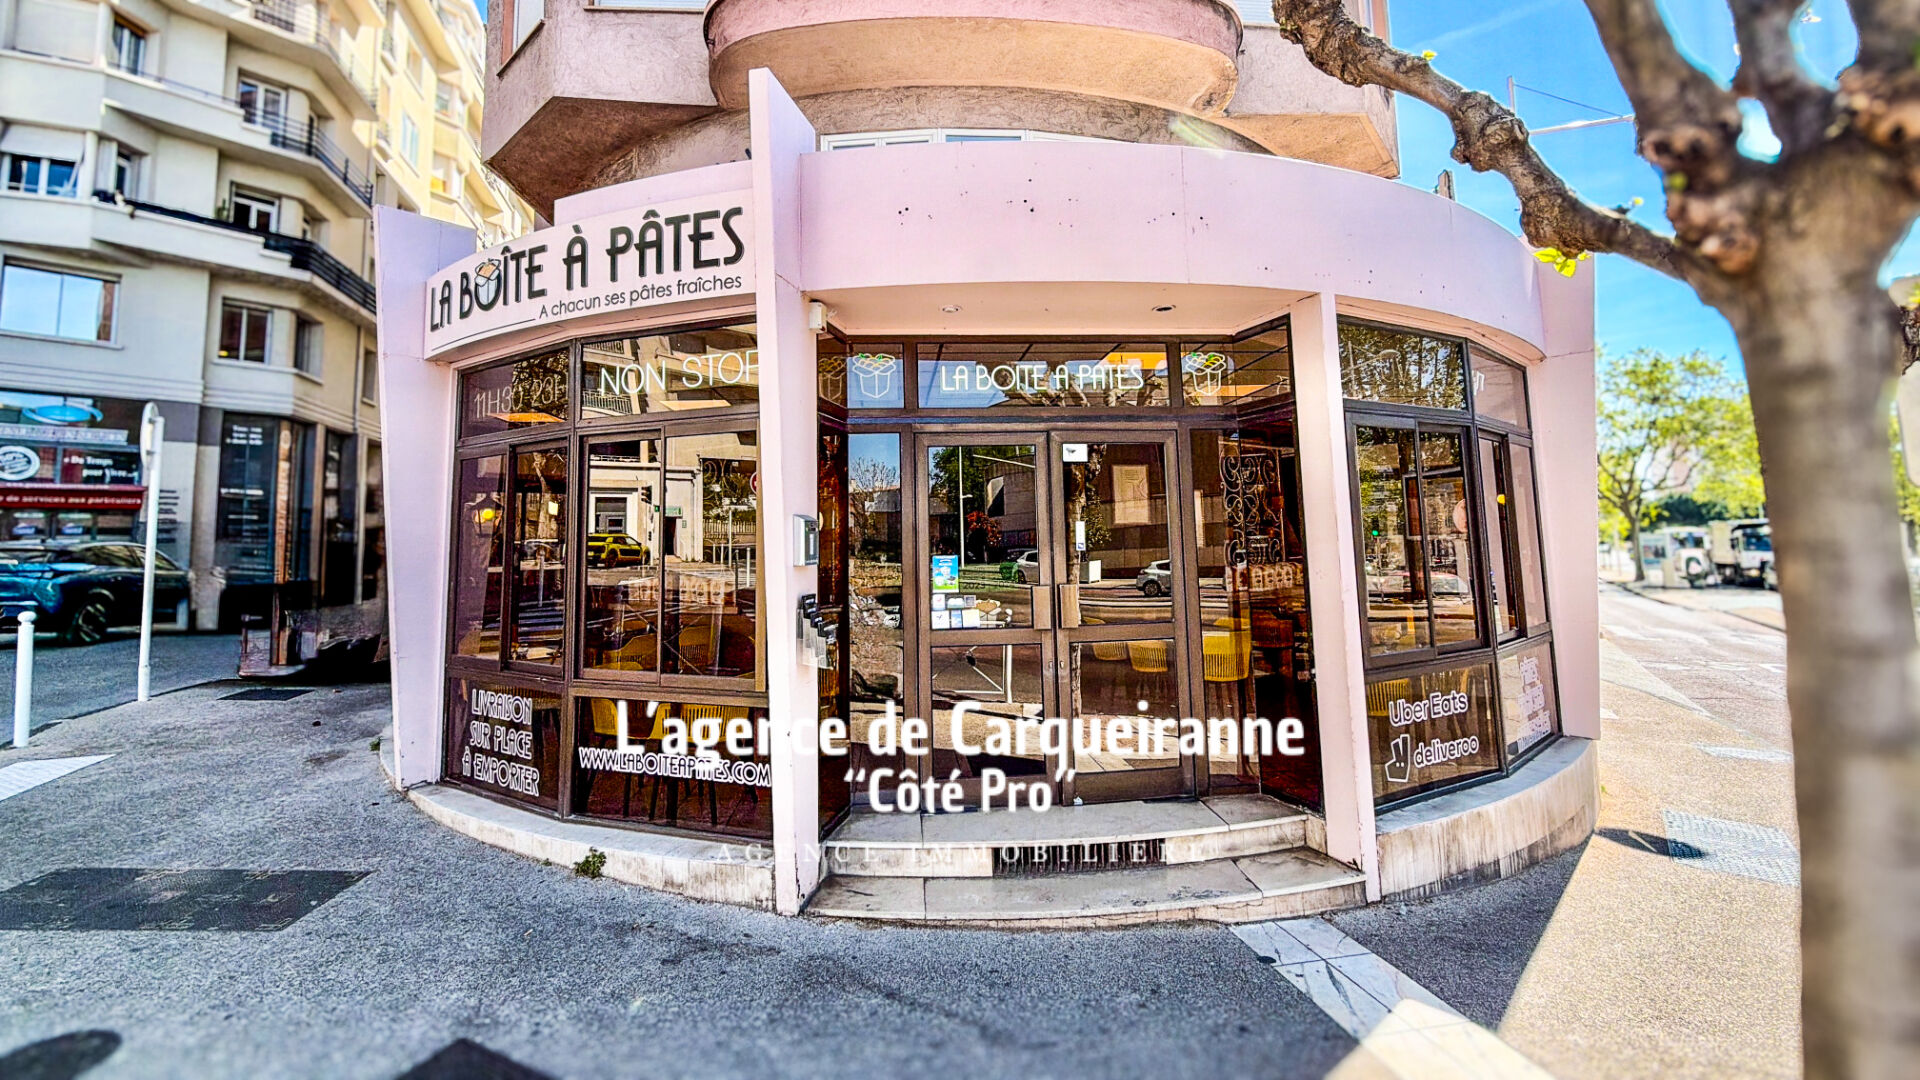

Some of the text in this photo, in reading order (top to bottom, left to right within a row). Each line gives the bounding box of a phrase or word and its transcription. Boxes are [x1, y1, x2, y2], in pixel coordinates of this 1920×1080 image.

[430, 206, 745, 333] LA BOÎTE À PÂTES
[539, 275, 742, 319] A chacun ses pâtes fraîches
[600, 360, 667, 397] NON
[941, 364, 1145, 391] LA BOITE A PATES
[471, 688, 533, 726] LIVRAISON
[1388, 690, 1469, 727] Uber Eats
[469, 720, 533, 760] SUR PLACE
[1413, 735, 1480, 768] deliveroo
[473, 752, 540, 797] EMPORTER
